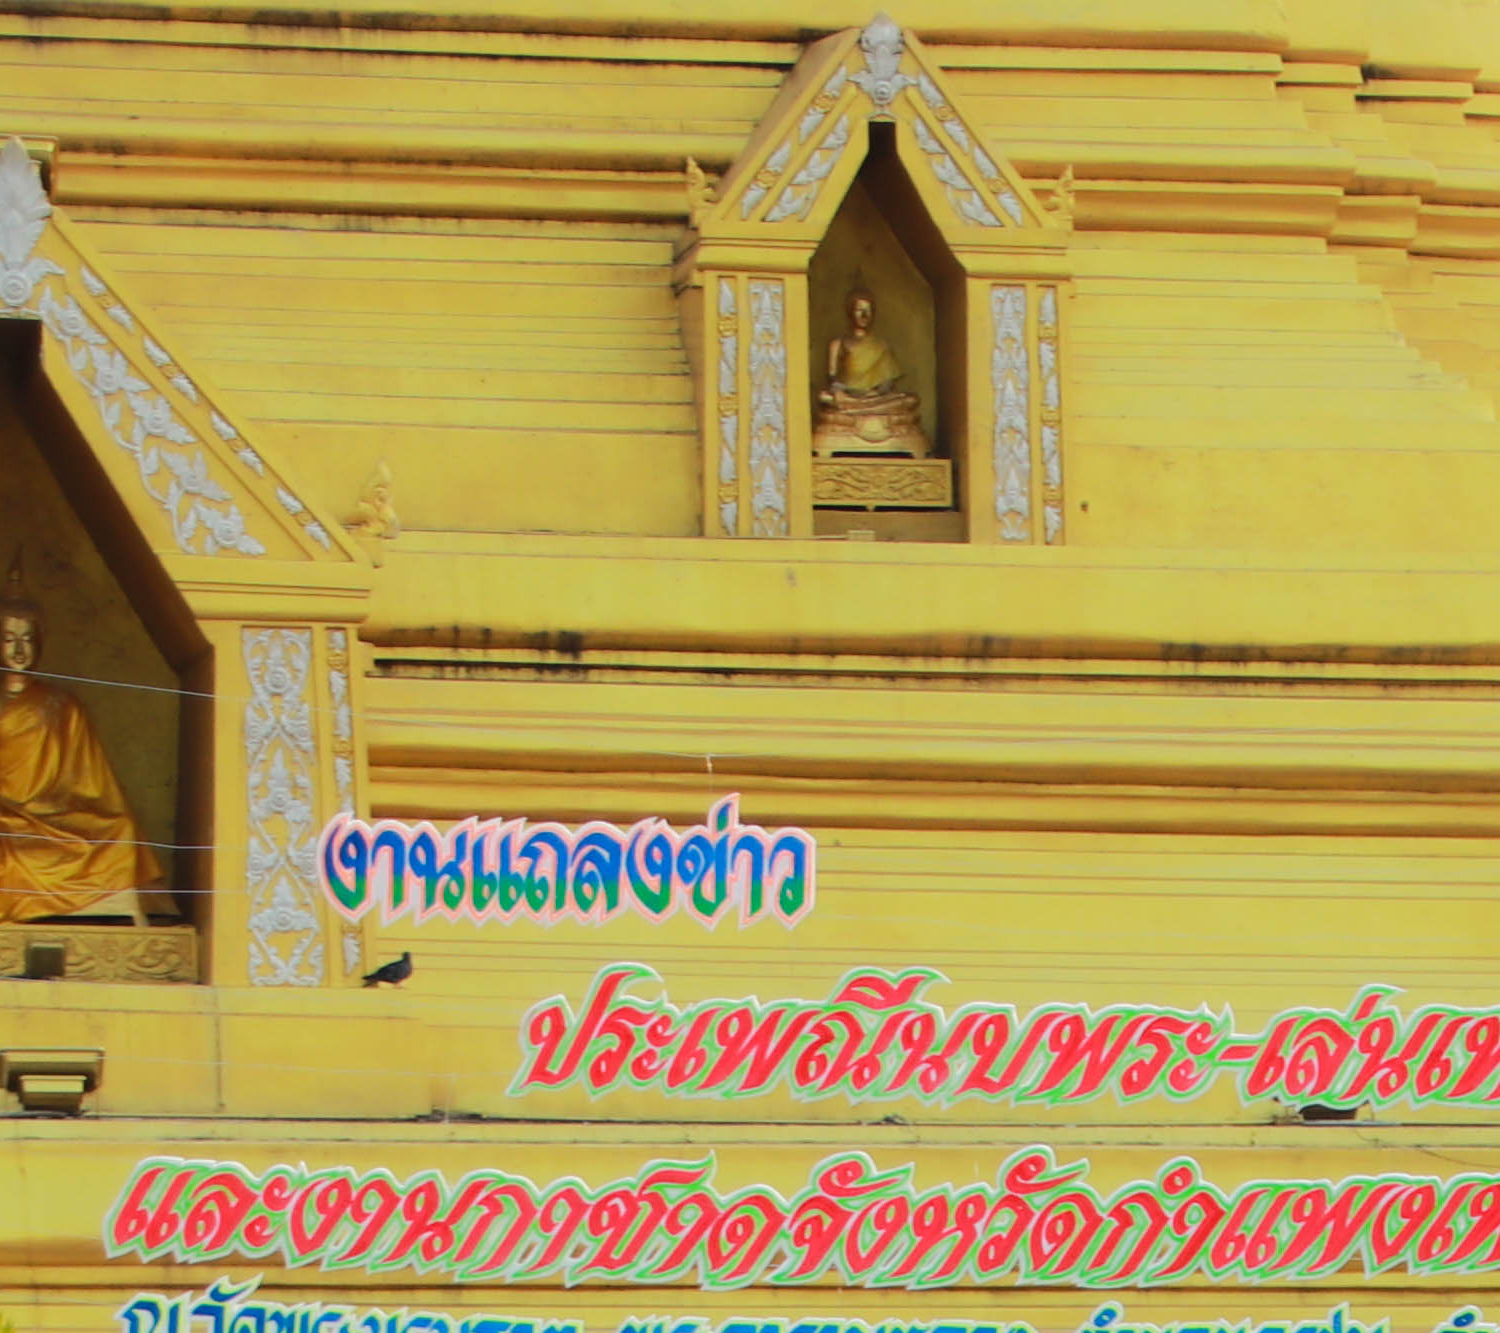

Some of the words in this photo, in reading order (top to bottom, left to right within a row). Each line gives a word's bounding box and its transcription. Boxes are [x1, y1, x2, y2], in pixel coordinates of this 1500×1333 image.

[320, 797, 814, 925] งานแถลงข่าว
